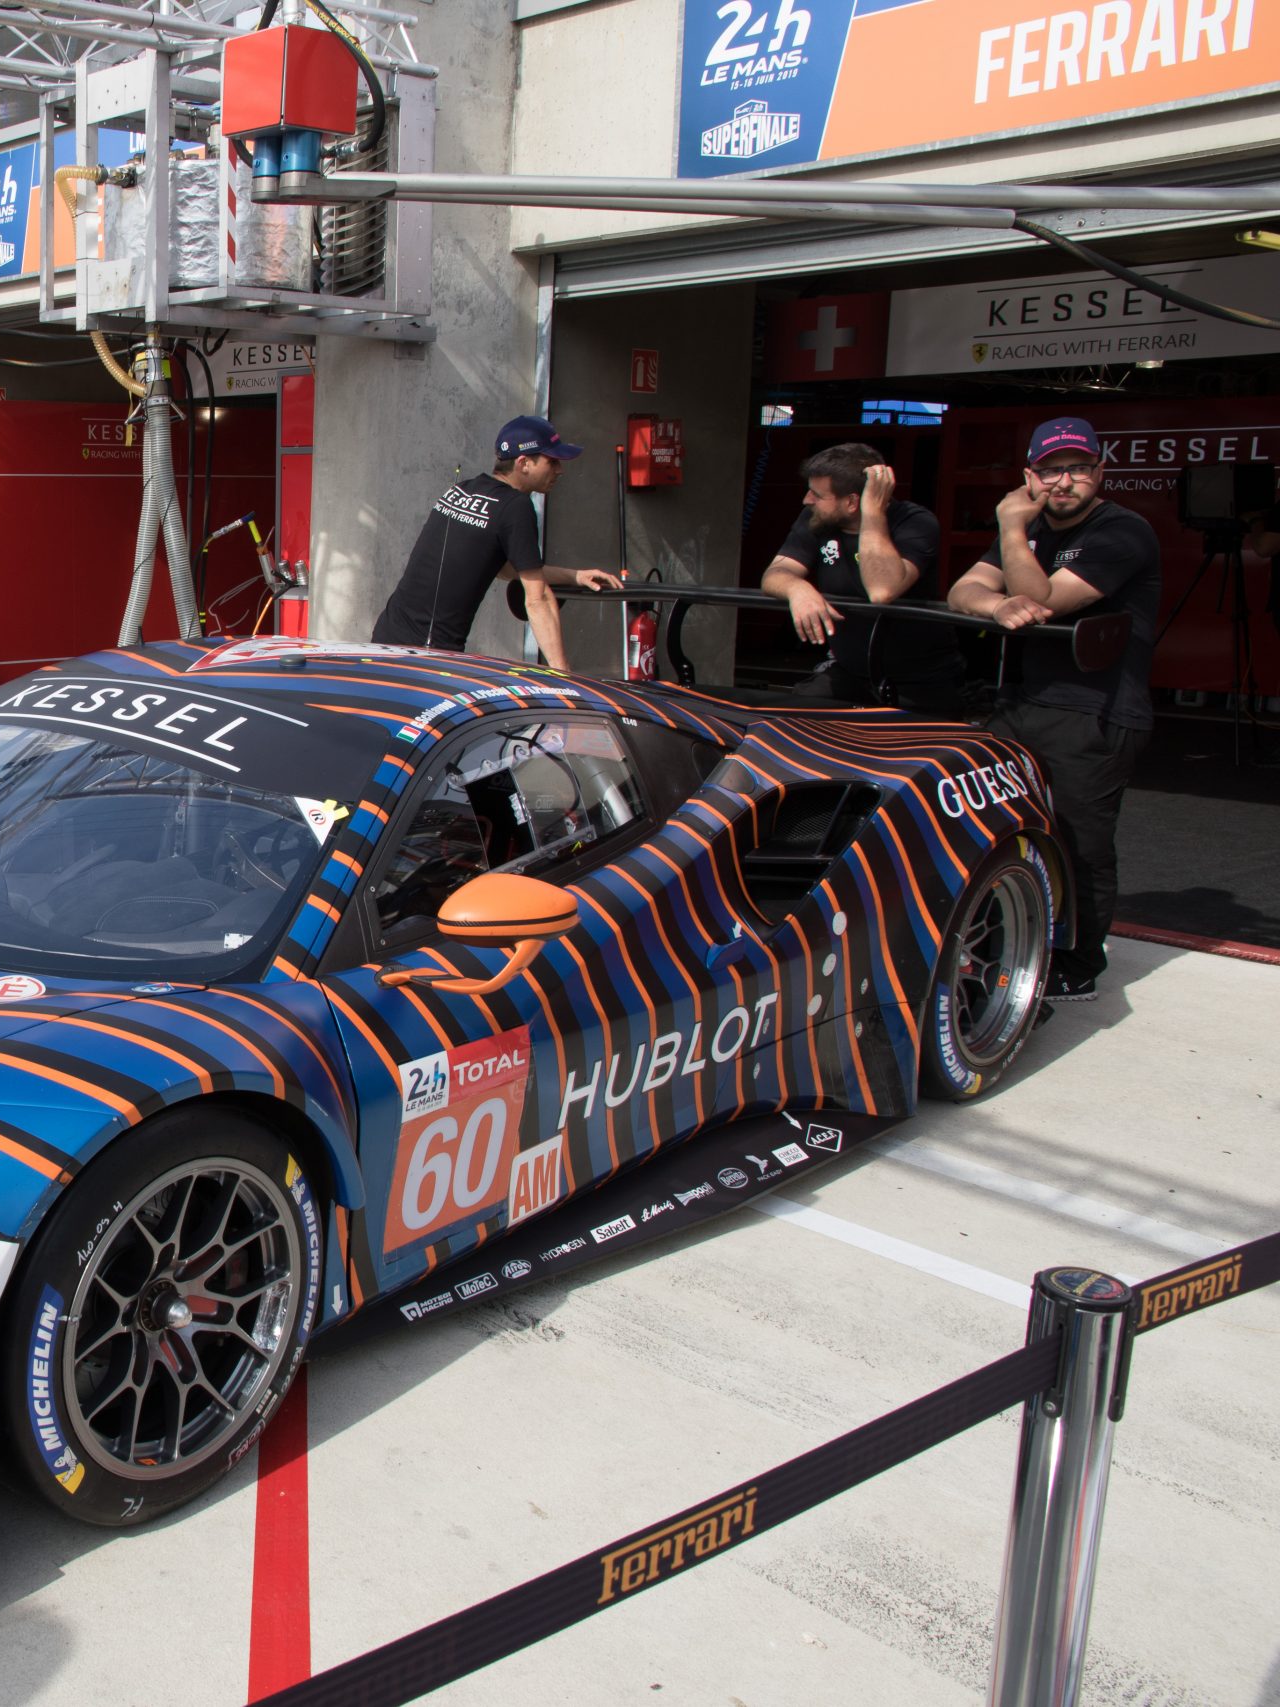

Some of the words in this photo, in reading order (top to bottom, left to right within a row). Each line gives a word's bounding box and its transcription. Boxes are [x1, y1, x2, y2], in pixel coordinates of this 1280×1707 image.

[974, 0, 1254, 104] FERRARI
[700, 65, 730, 86] LE
[730, 77, 753, 91] 15-16
[755, 74, 774, 86] JUIN
[777, 68, 799, 81] 2019
[703, 115, 798, 156] SUPERFINALE
[988, 284, 1181, 327] KESSEL
[992, 342, 1058, 360] RACING
[1062, 339, 1111, 354] WITH
[1118, 333, 1197, 351] FERRARI
[235, 377, 265, 389] RACING
[91, 450, 120, 459] RACING
[120, 451, 142, 459] WITH
[1102, 436, 1269, 463] KESSEL
[1104, 478, 1162, 491] RACING
[442, 487, 489, 515] KESSEL
[456, 512, 488, 529] FERRARI
[937, 760, 1028, 818] GUESS
[939, 994, 968, 1084] MICHELIN
[453, 1050, 526, 1086] TOTAL
[557, 992, 778, 1130] HUBLOT
[405, 1100, 417, 1112] LE
[417, 1091, 443, 1108] MANS
[402, 1097, 507, 1230] 60
[778, 1147, 799, 1159] CHICCO
[512, 1149, 558, 1219] AM
[720, 1171, 746, 1186] Beretta
[757, 1173, 770, 1181] PACK
[770, 1168, 783, 1178] EASY
[595, 1218, 631, 1241] Sabelt
[539, 1237, 587, 1262] HYDROGEN
[301, 1200, 320, 1333] MICHELIN
[504, 1260, 530, 1276] Airoh
[420, 1291, 451, 1308] MOTEGI
[461, 1276, 492, 1297] MoTeC
[1137, 1253, 1243, 1329] Ferrari
[422, 1296, 454, 1313] RACING
[32, 1301, 62, 1451] MICHELIN
[597, 1486, 758, 1605] Ferrari
